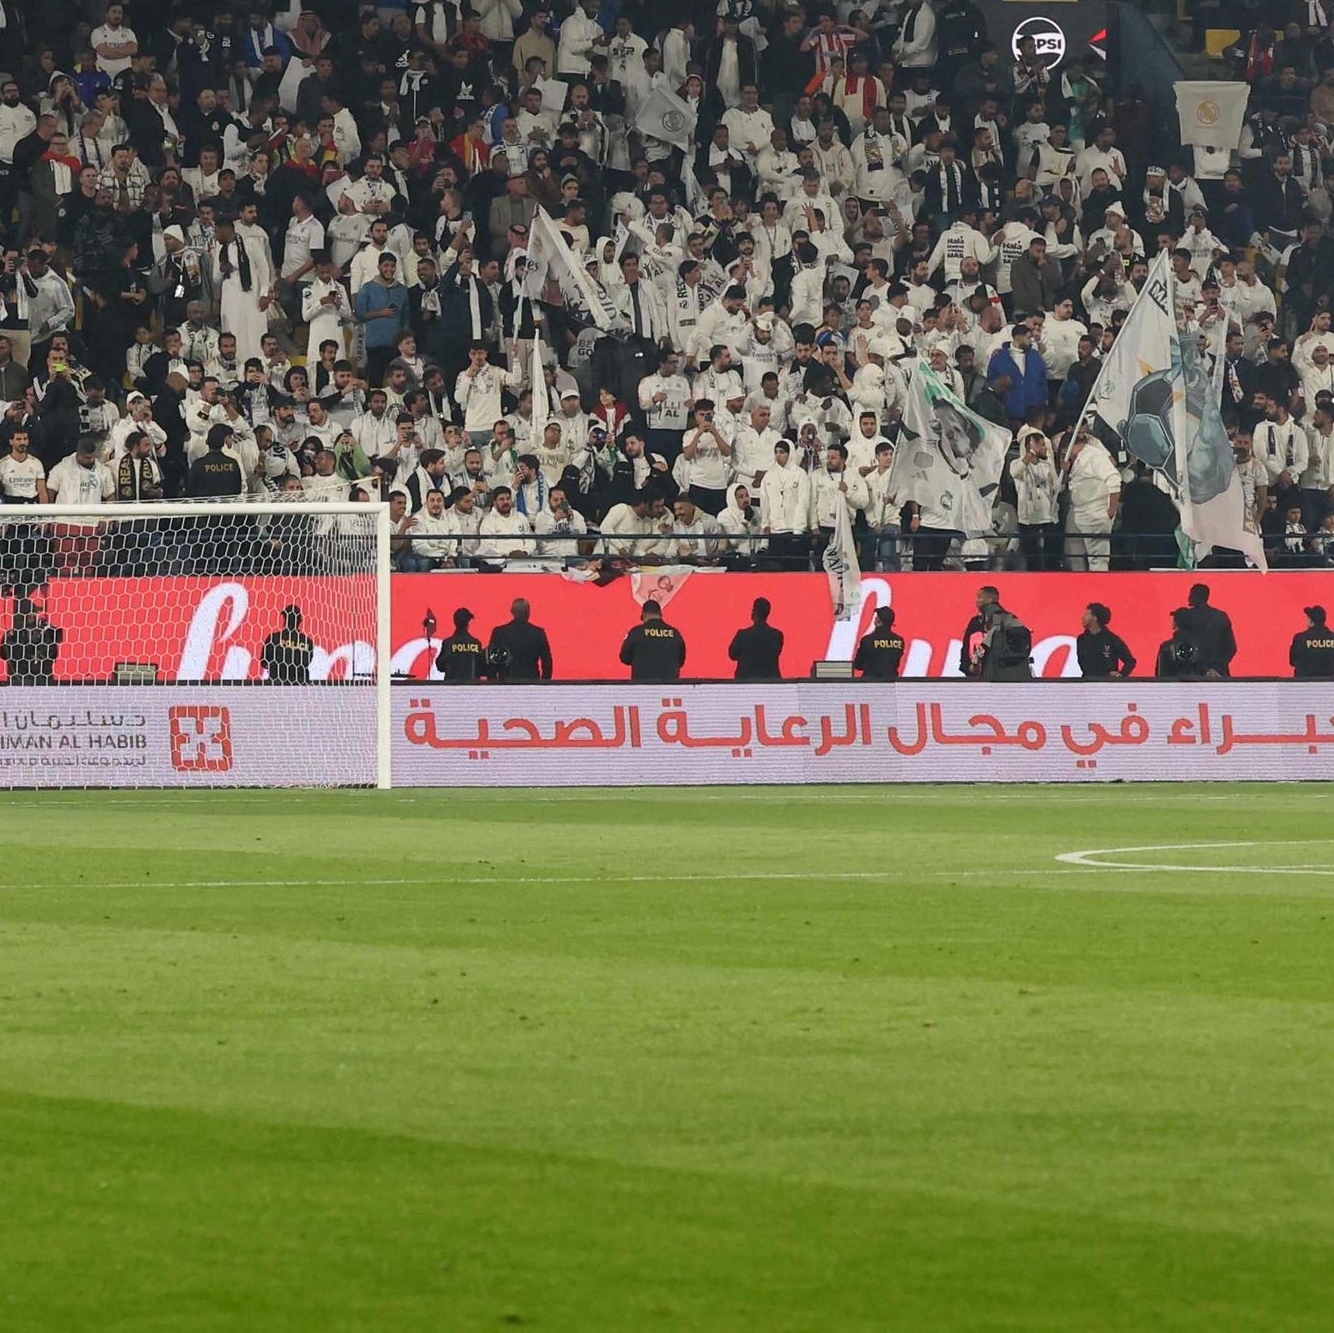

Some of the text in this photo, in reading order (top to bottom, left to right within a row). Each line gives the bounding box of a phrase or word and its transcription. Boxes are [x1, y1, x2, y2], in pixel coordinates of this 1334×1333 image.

[204, 463, 234, 473] POLICE
[643, 628, 674, 638] POLICE
[279, 638, 310, 652] POLICE
[452, 643, 480, 653] POLICE
[874, 639, 903, 649] POLICE
[1306, 640, 1334, 649] POLICE
[404, 698, 641, 760] الصحية
[656, 698, 872, 757] الرعاية
[888, 702, 1046, 756] مجال
[60, 735, 82, 750] AL
[90, 734, 147, 750] HABIB
[1061, 702, 1149, 768] في
